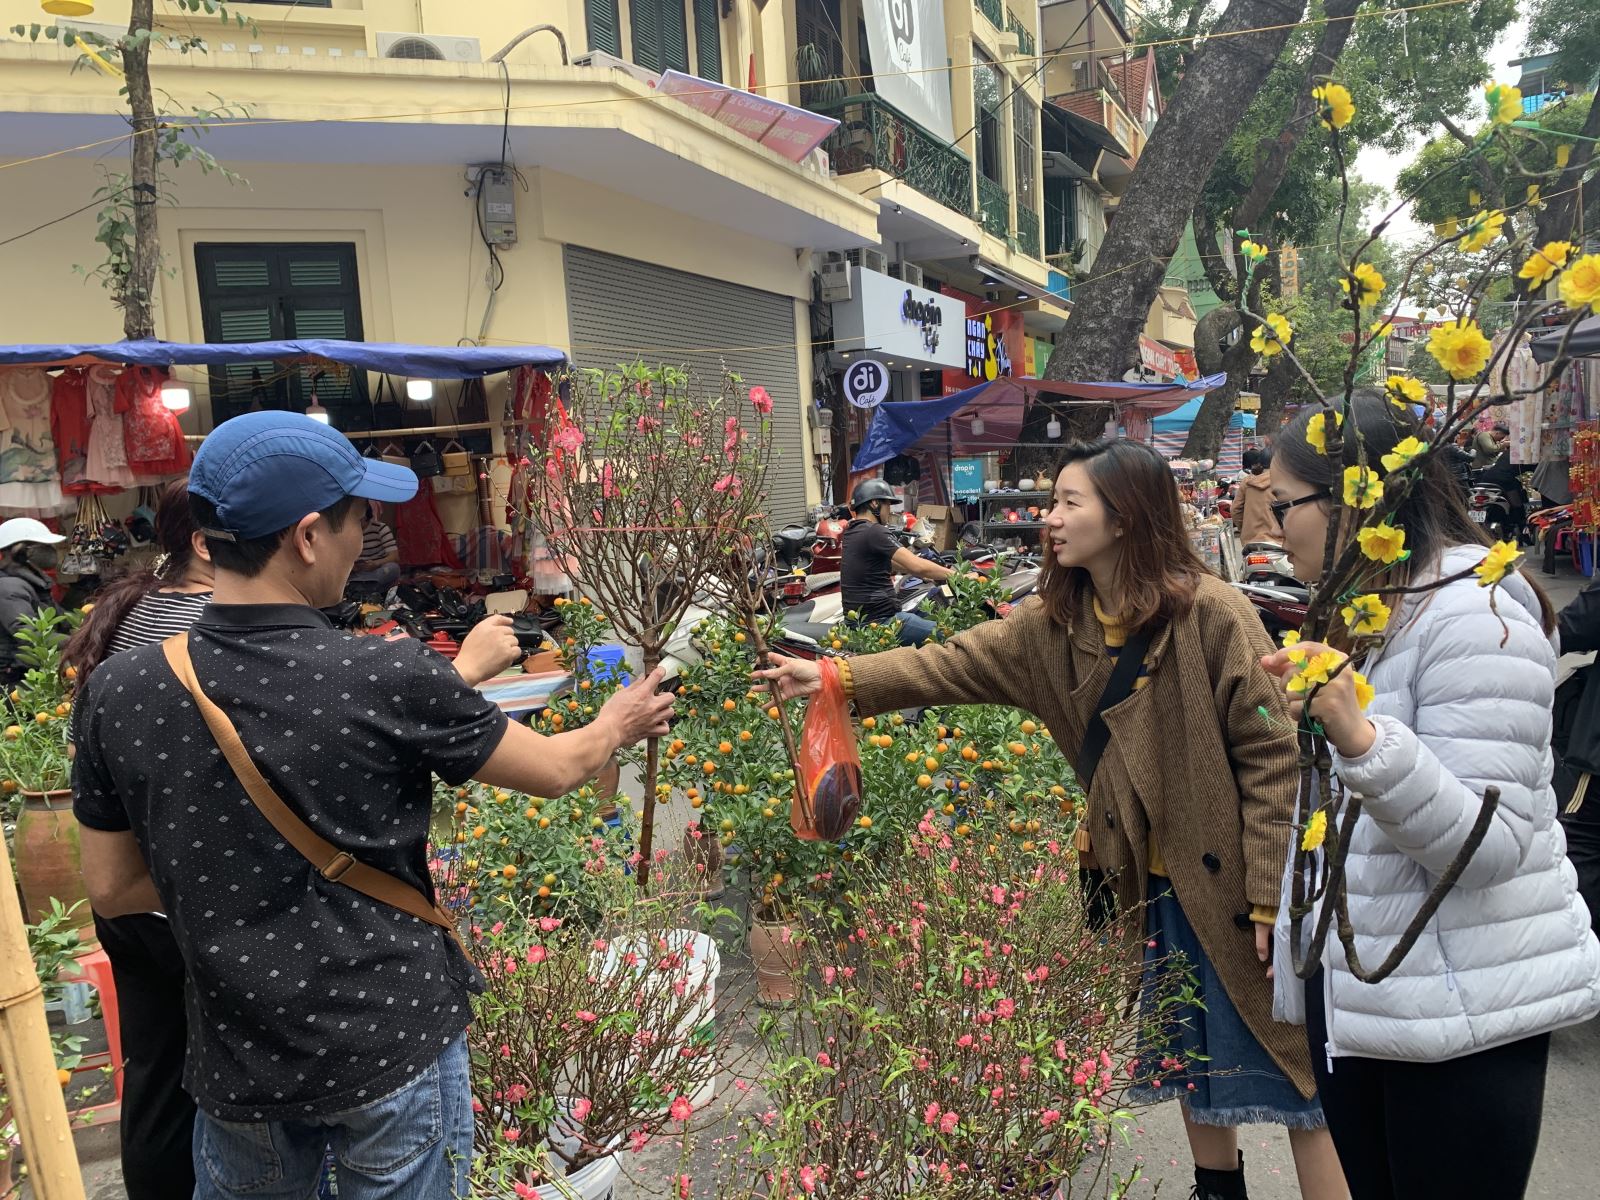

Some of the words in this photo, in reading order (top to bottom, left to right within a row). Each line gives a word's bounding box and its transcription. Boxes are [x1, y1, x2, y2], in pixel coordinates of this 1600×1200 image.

[967, 319, 986, 339] NGAN
[967, 339, 986, 359] CHÁY
[853, 366, 875, 391] di
[859, 394, 876, 407] Café
